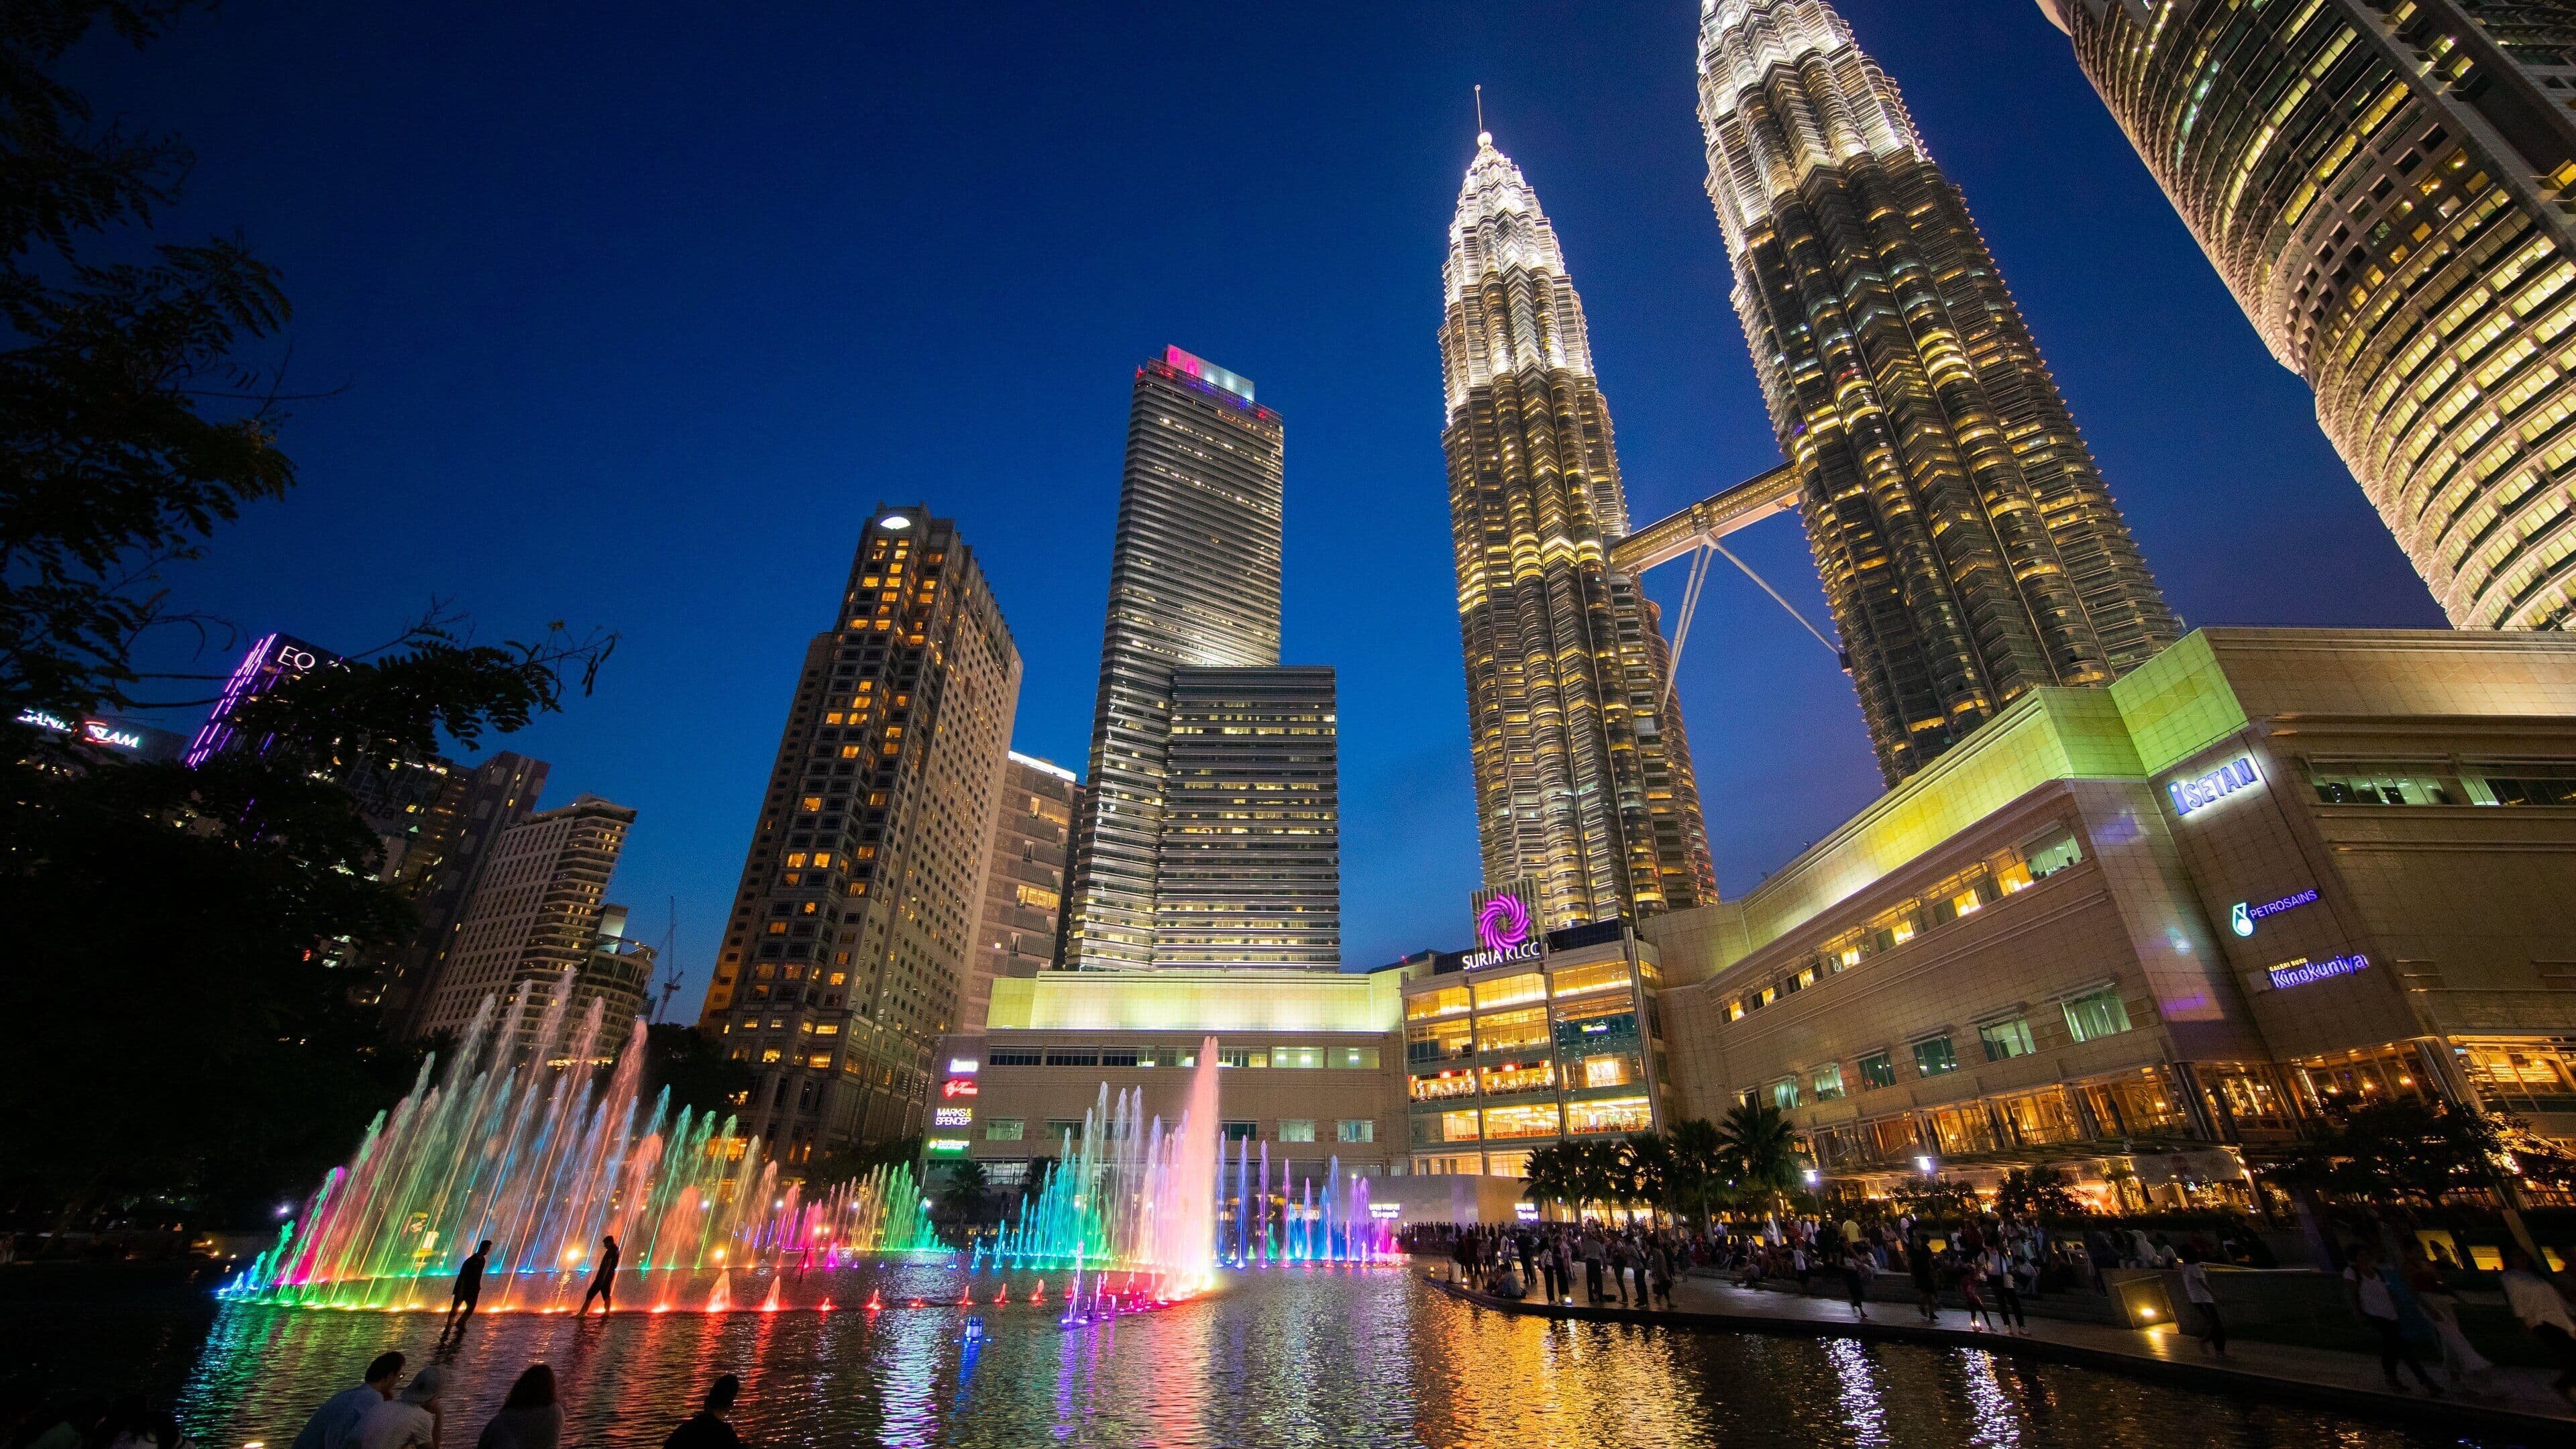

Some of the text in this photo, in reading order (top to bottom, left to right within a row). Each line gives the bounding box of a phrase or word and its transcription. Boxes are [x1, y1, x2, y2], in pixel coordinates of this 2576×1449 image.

[277, 645, 315, 671] EQ
[2249, 890, 2317, 919] PETROSAINS
[1462, 942, 1540, 970] SURIA KLCC
